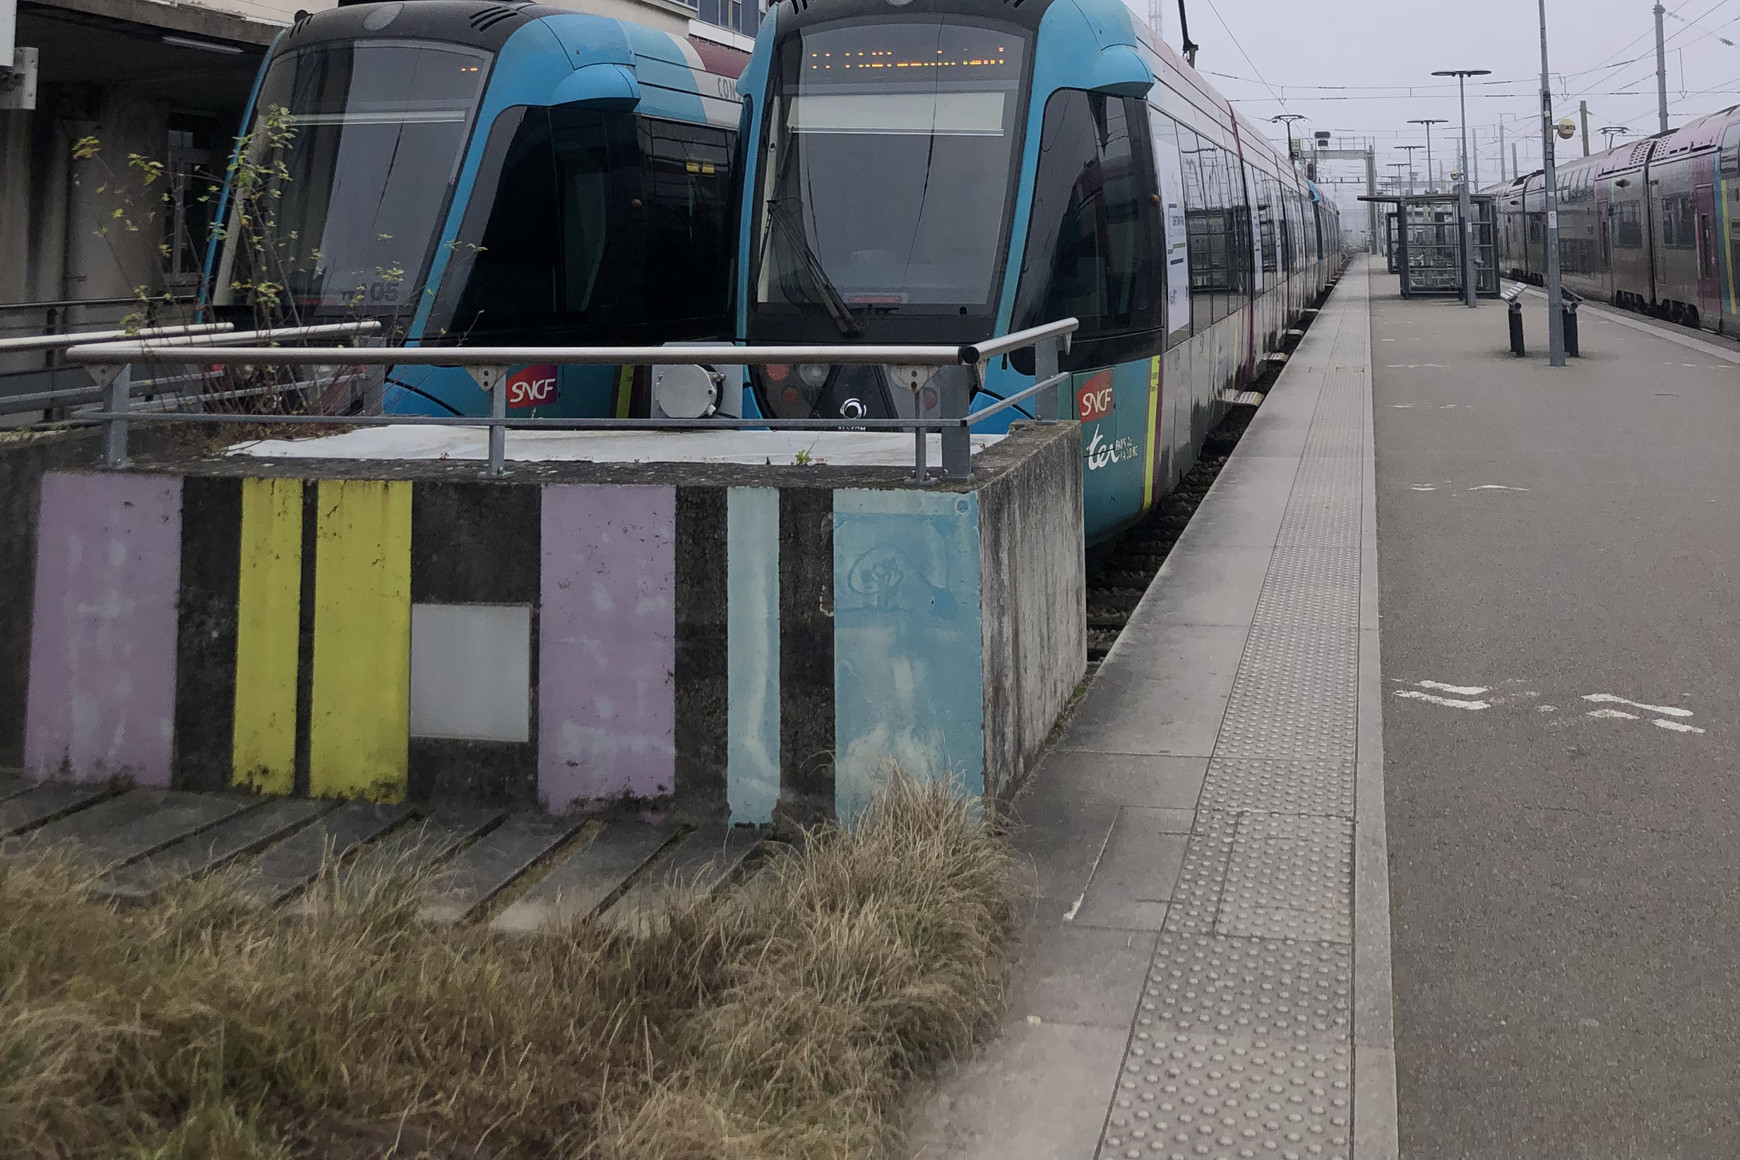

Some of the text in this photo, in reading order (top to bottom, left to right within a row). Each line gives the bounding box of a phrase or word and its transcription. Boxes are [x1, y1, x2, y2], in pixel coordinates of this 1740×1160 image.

[510, 378, 556, 403] SNCF
[1081, 387, 1113, 416] SNCF
[1086, 423, 1120, 471] ter
